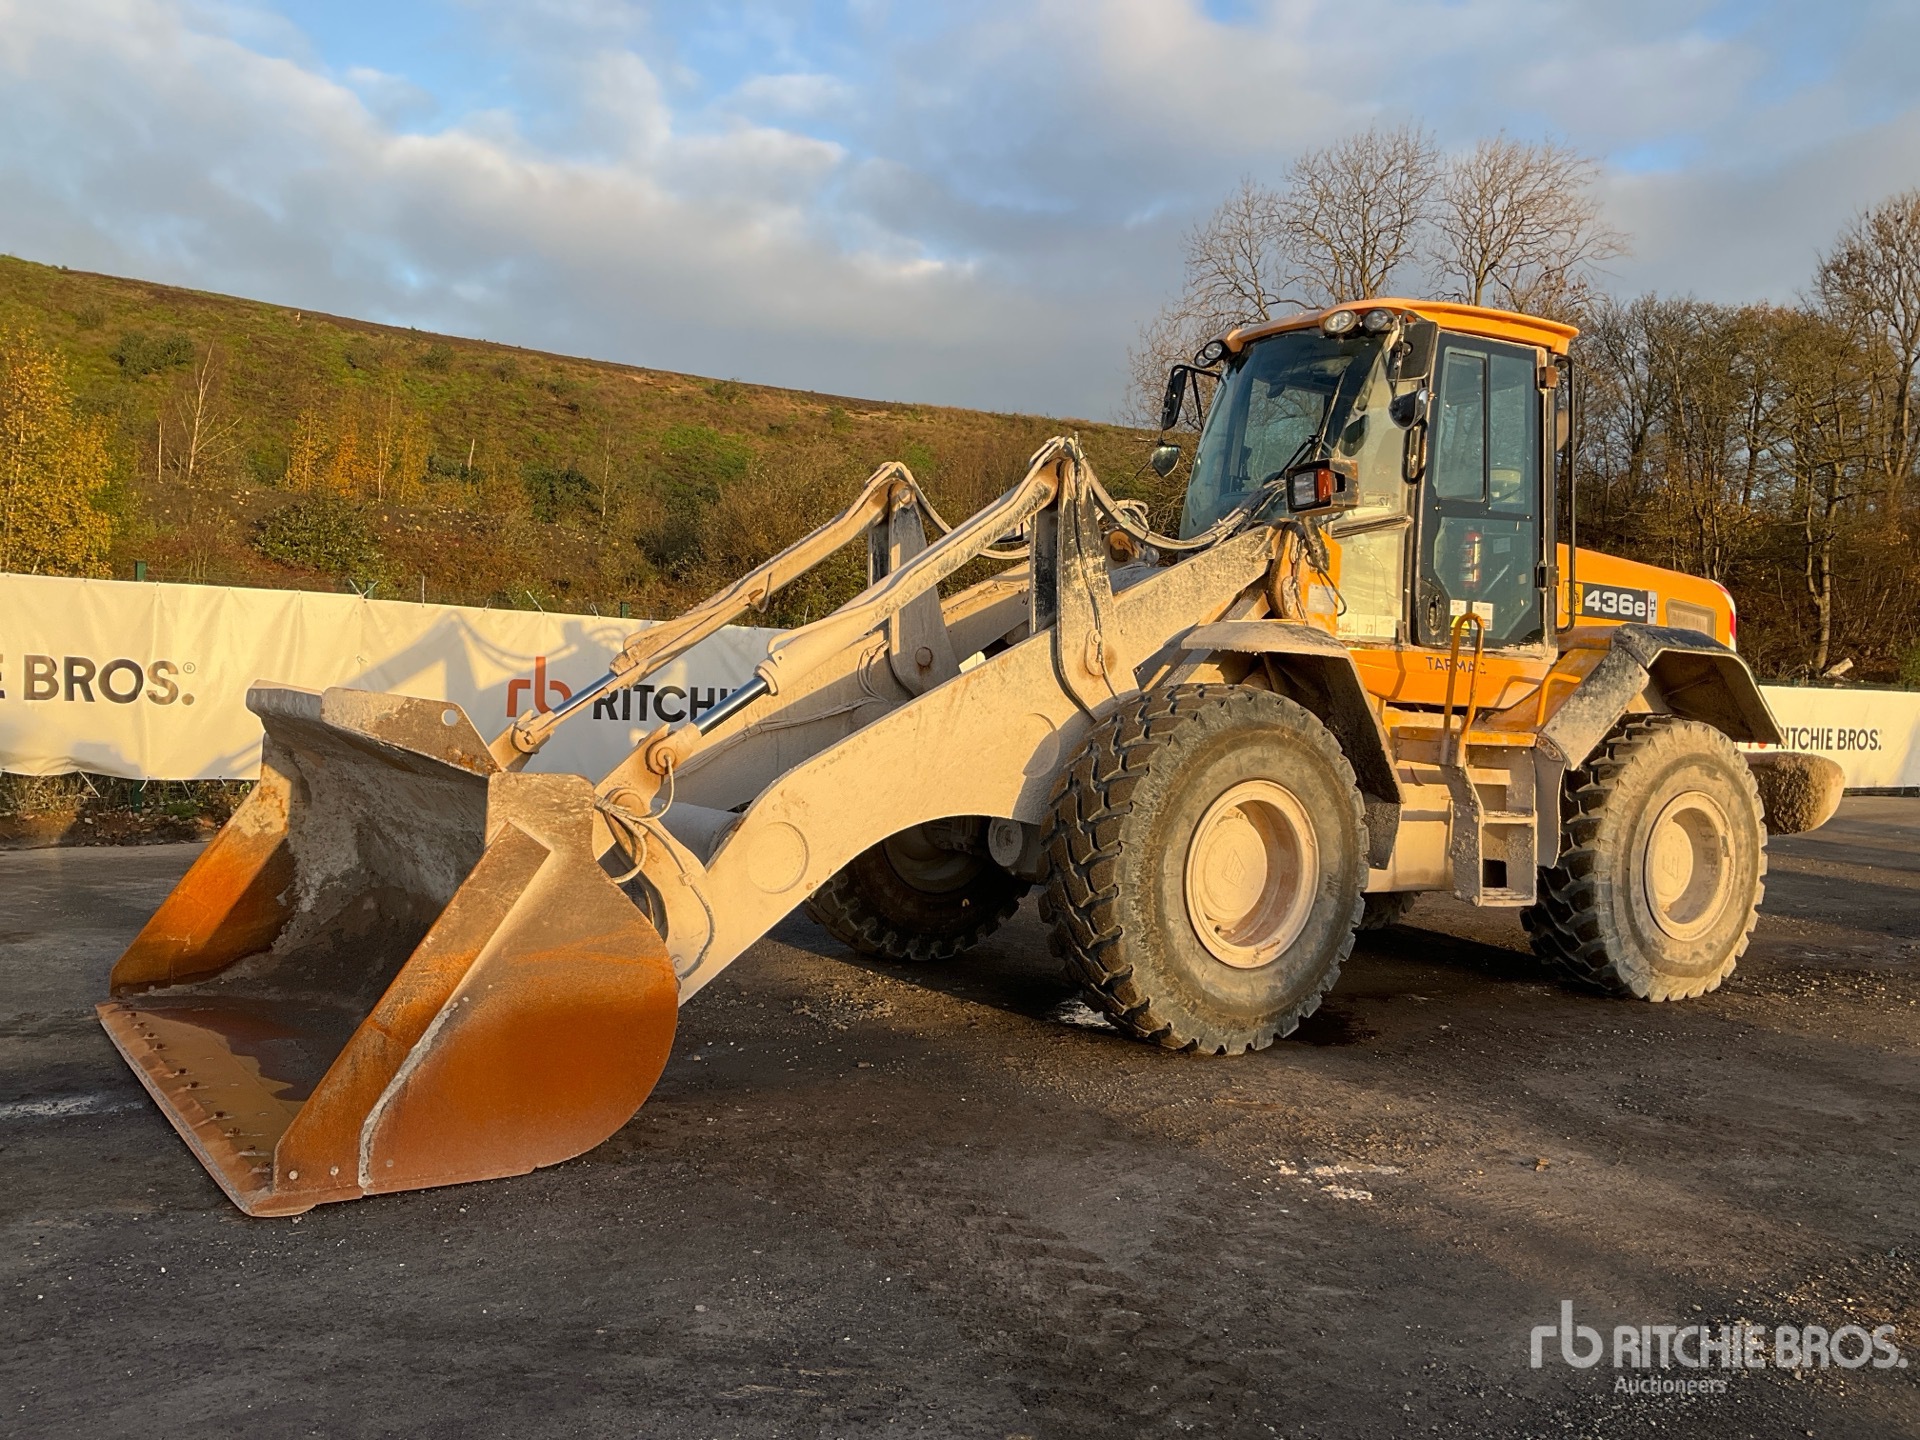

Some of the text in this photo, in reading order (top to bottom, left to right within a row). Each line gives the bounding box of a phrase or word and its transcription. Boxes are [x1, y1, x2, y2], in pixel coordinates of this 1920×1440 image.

[1584, 590, 1647, 617] 436e
[593, 684, 739, 723] RITCH
[1837, 728, 1882, 751] BROS.
